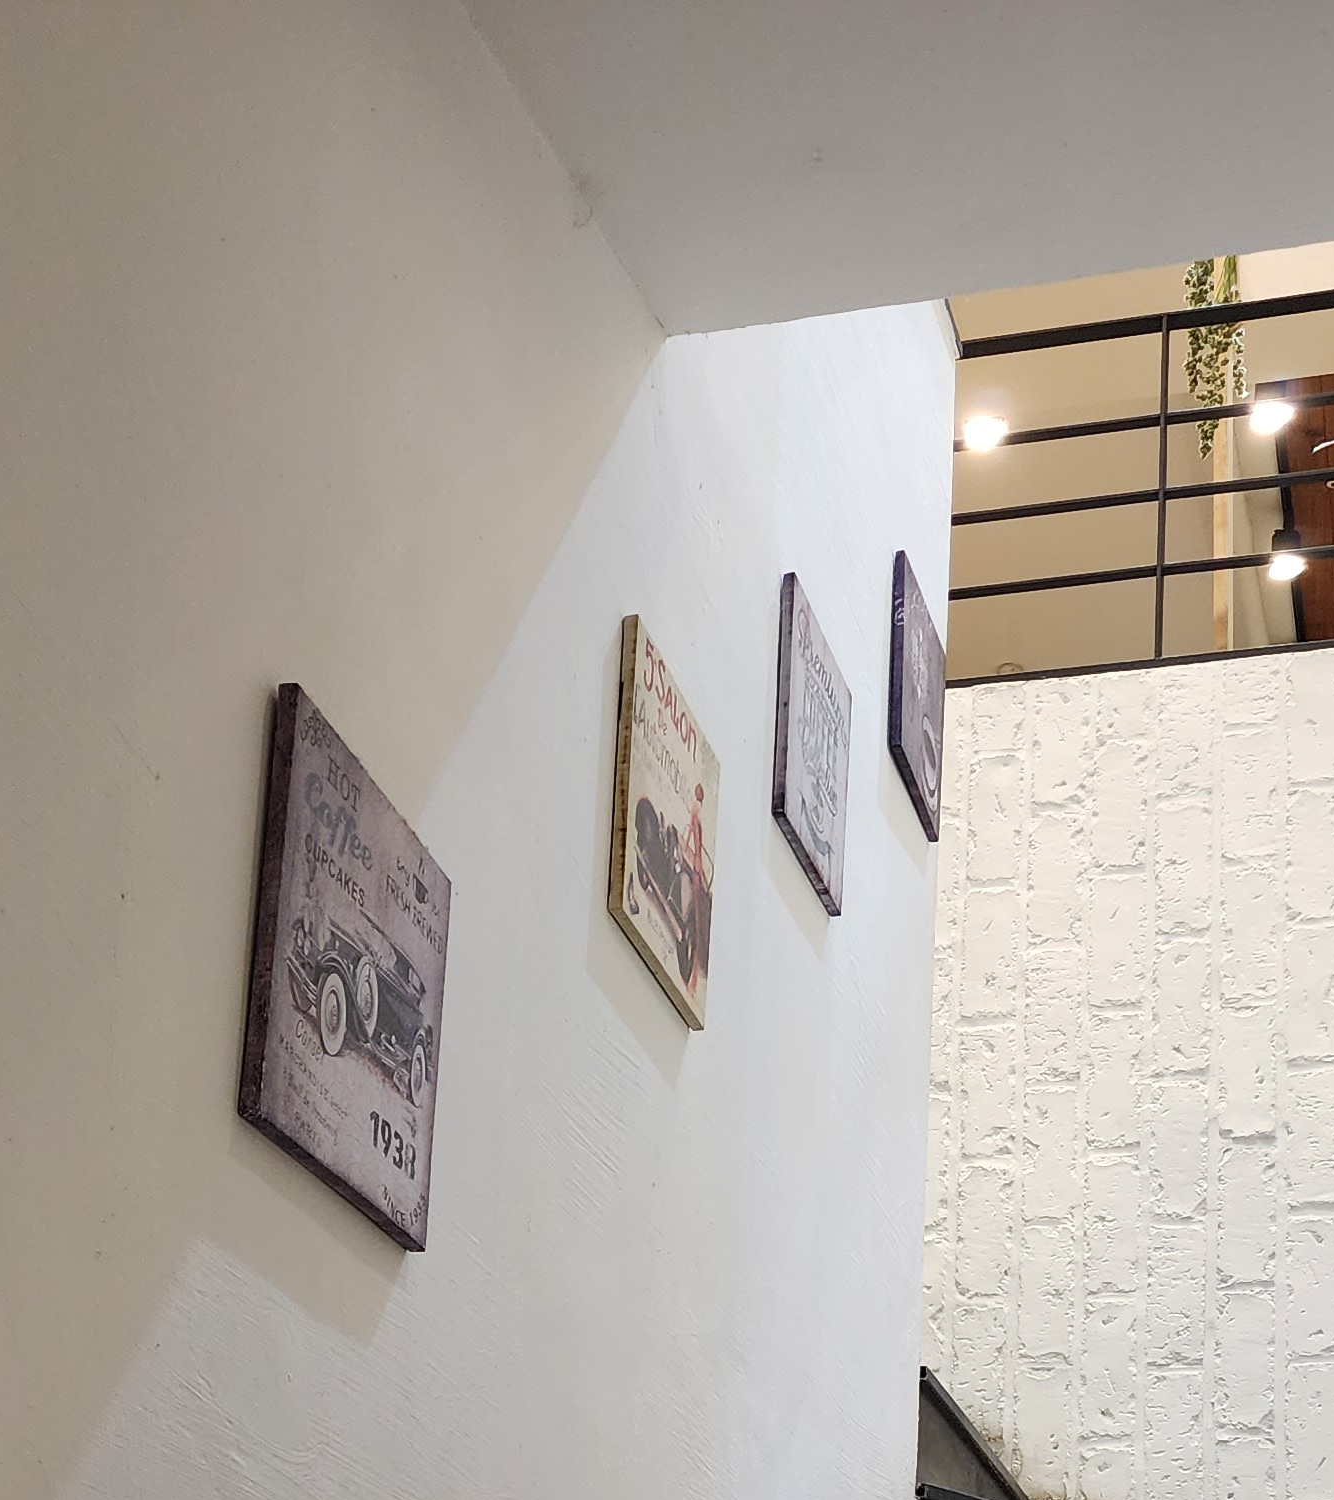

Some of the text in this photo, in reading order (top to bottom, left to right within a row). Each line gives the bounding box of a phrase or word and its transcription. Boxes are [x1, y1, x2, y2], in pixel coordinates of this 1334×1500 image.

[327, 754, 361, 814] HOT
[305, 772, 373, 871] Coffee
[304, 832, 366, 909] CUPCAKES
[369, 1110, 417, 1181] 1938
